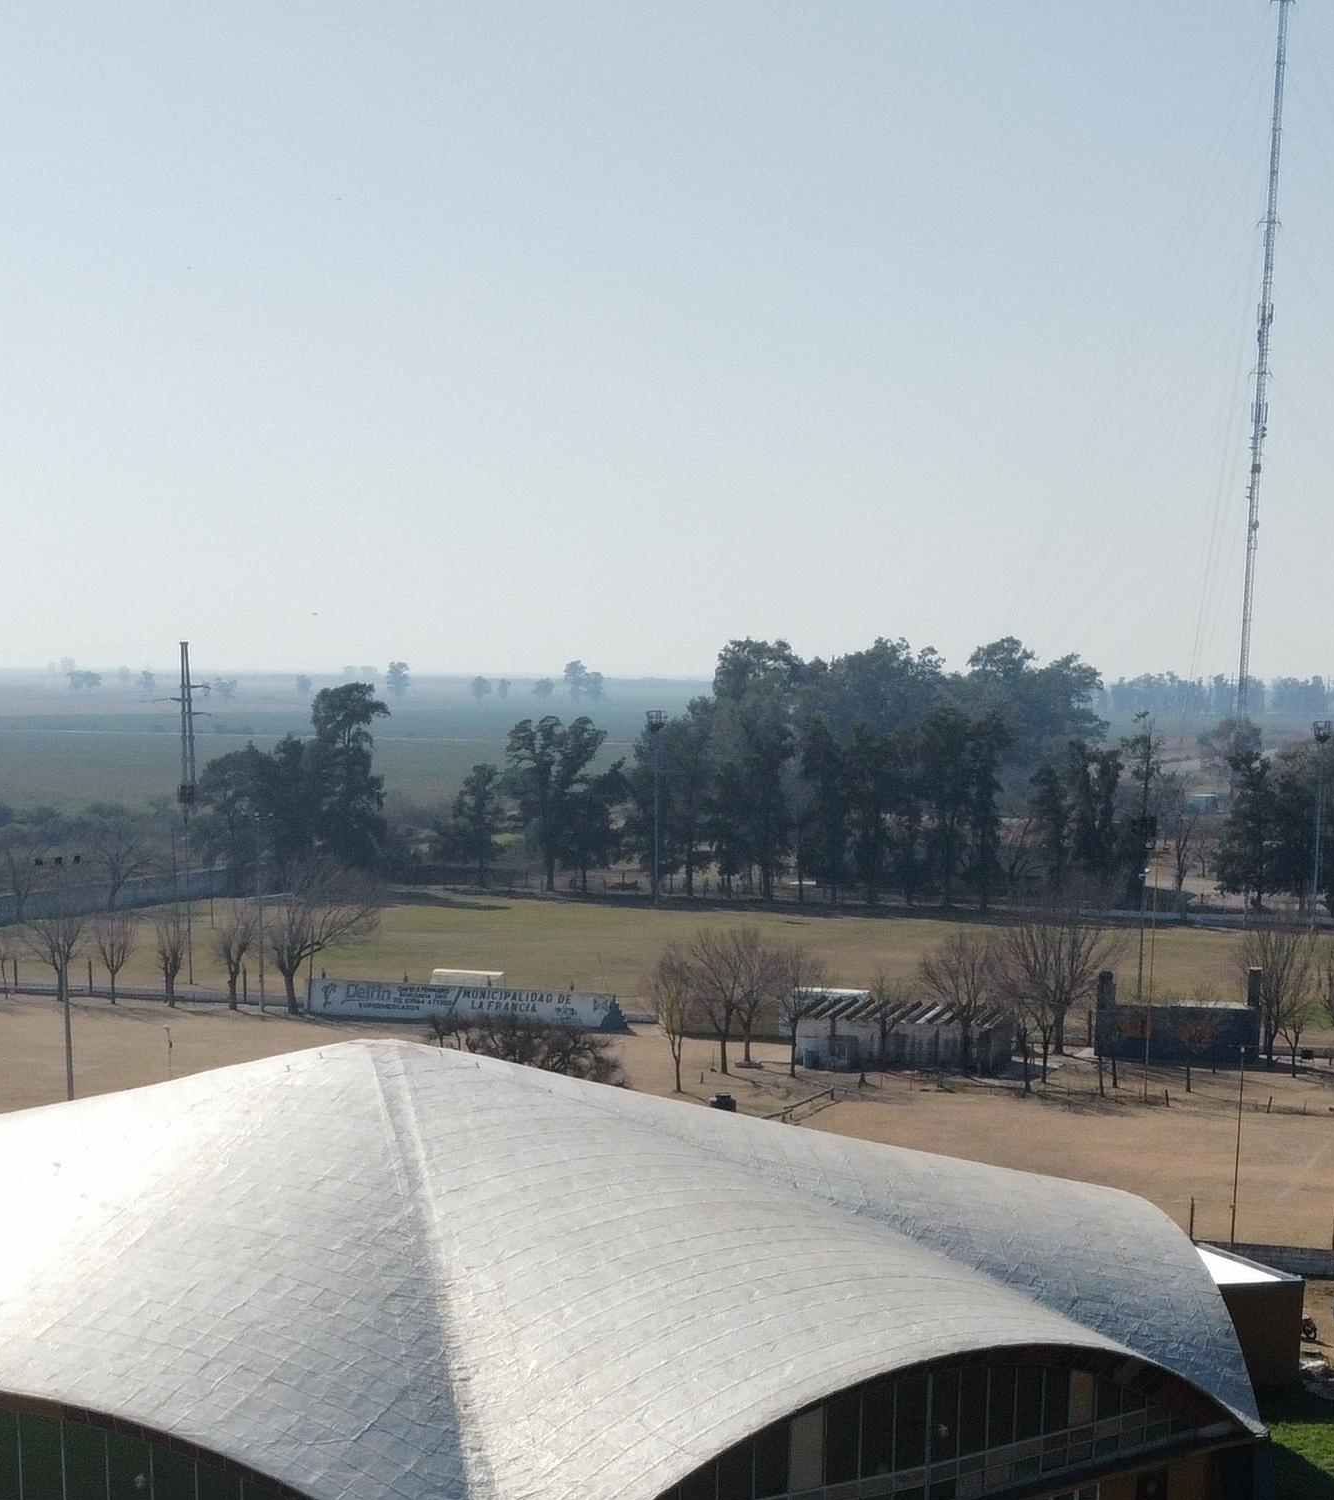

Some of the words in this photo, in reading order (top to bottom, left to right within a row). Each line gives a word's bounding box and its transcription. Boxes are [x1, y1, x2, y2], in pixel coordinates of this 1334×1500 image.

[462, 989, 553, 1003] MUNICIPALIDAD
[558, 993, 572, 1004] DE
[471, 1001, 483, 1010] LA
[487, 1001, 537, 1013] FRANCIA
